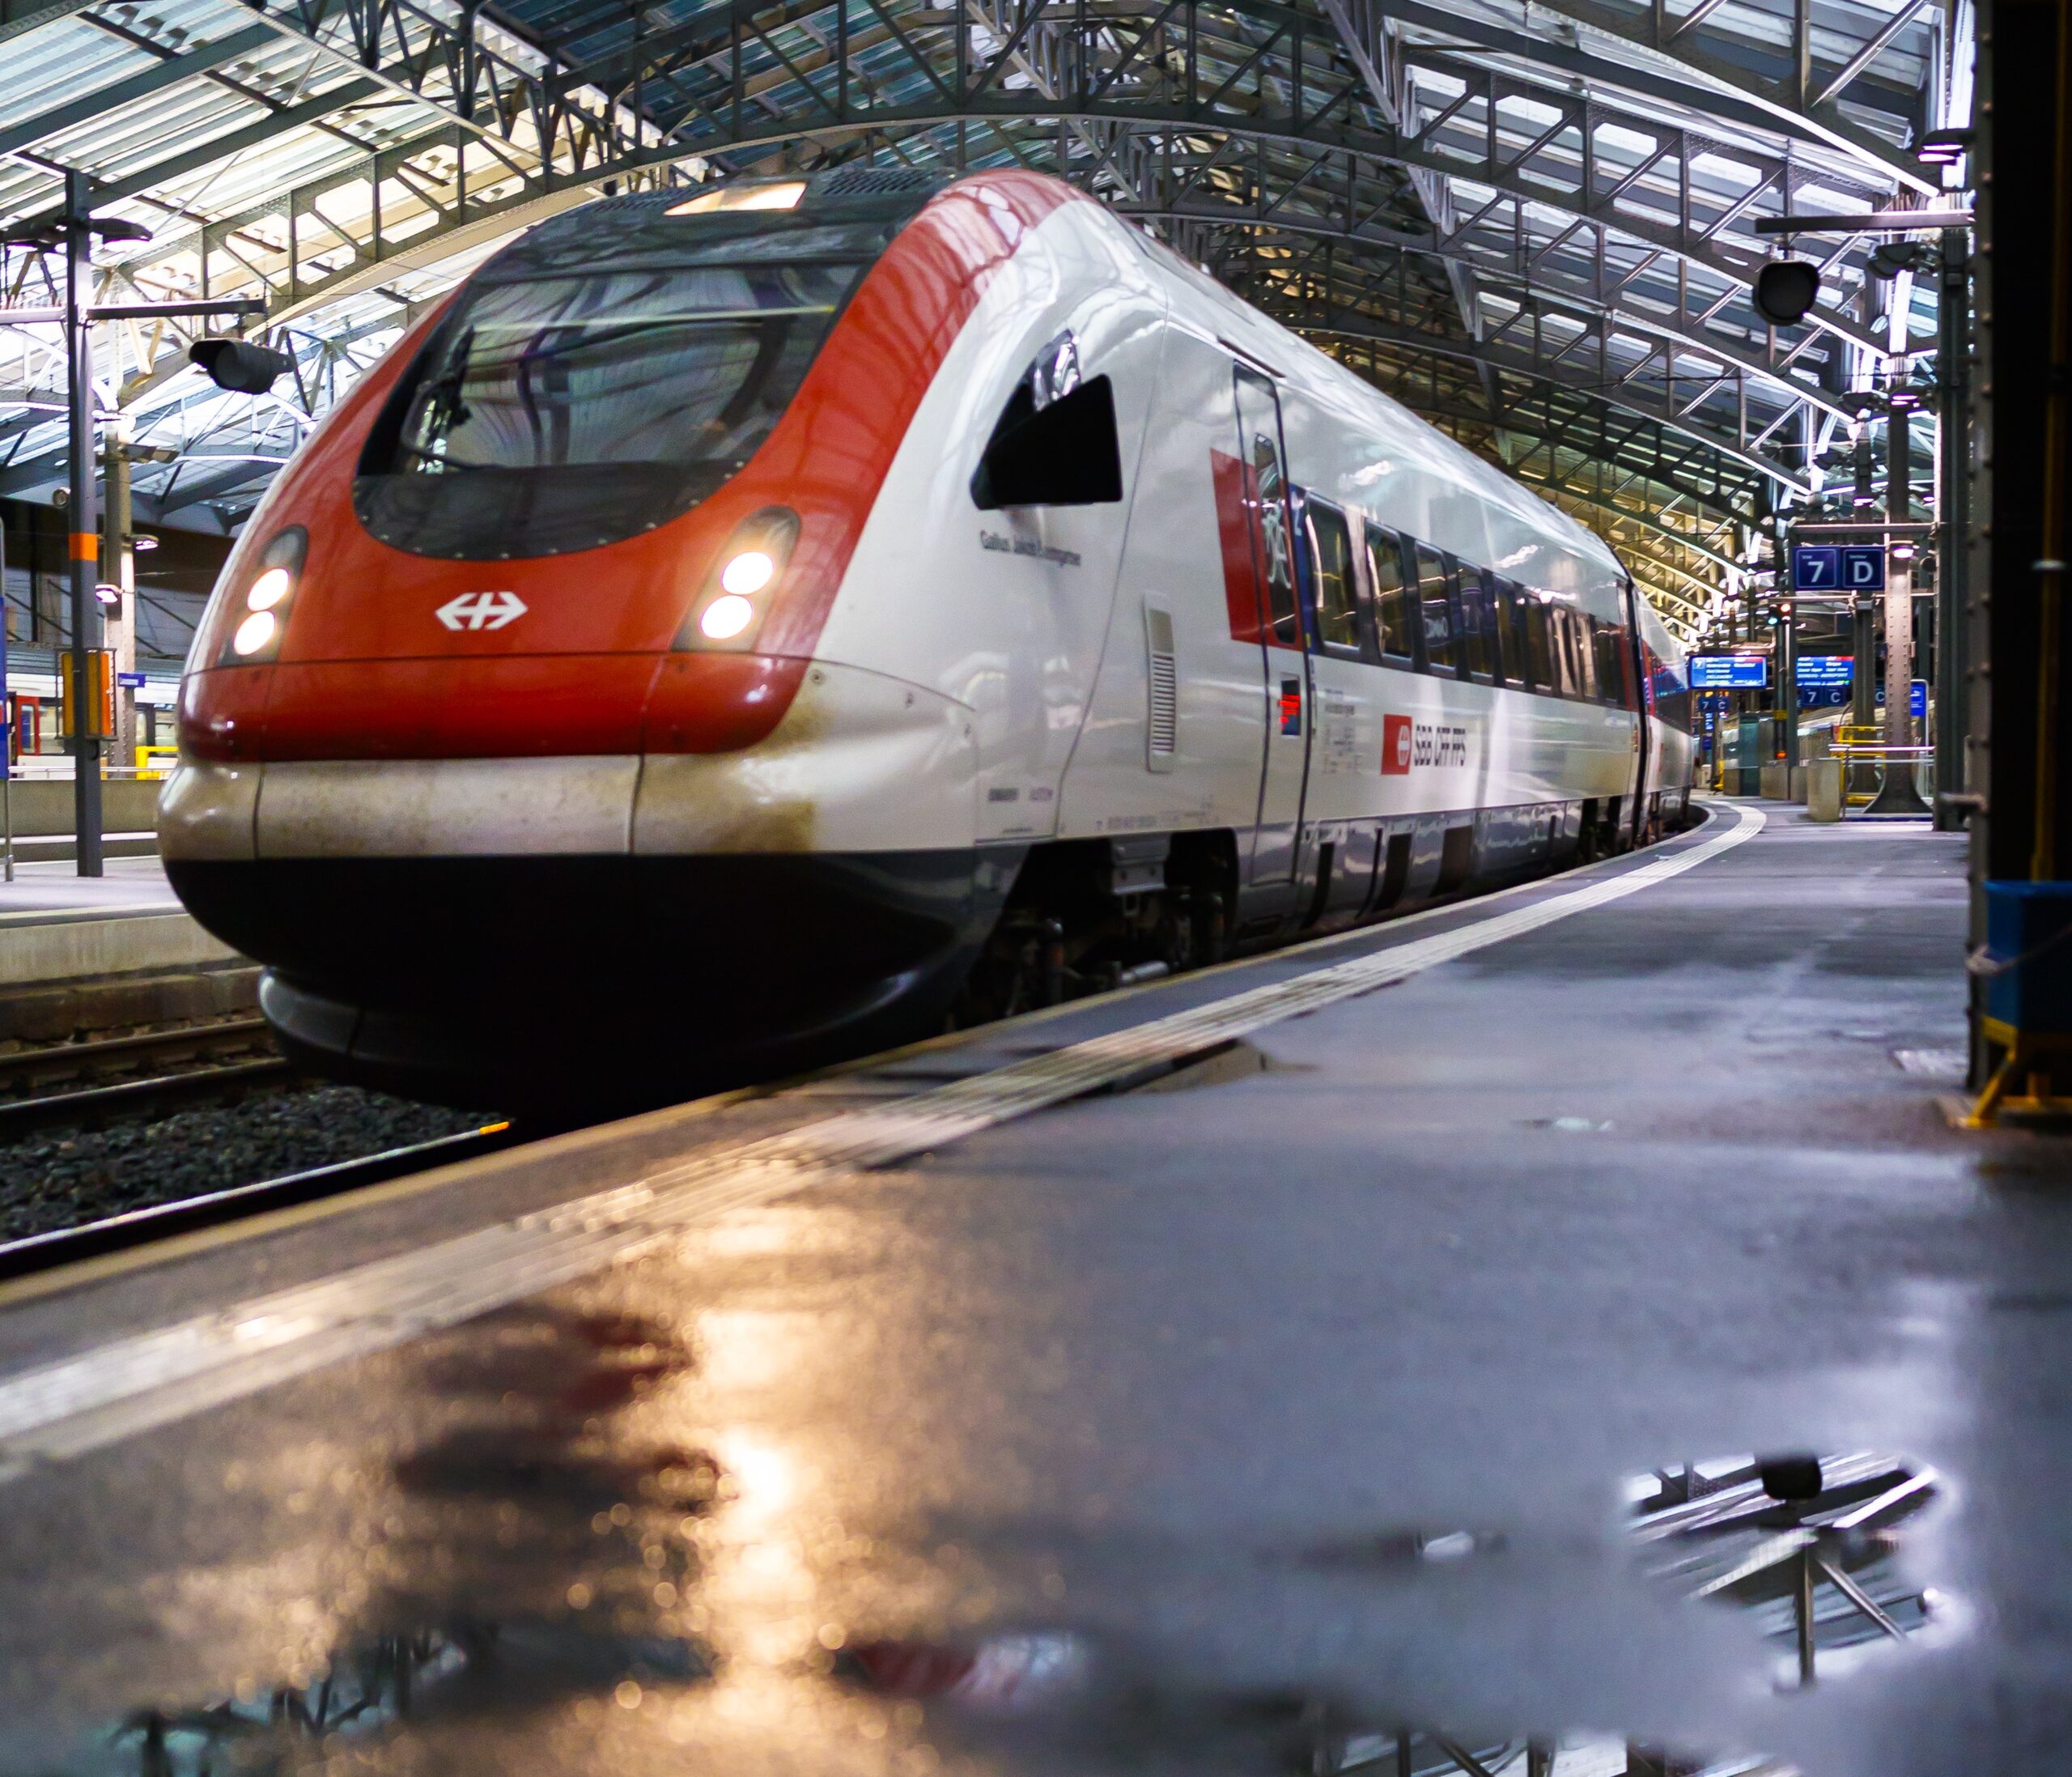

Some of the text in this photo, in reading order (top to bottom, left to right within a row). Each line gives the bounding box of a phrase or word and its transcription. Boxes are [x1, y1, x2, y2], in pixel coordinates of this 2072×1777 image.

[1807, 561, 1824, 583] 7
[1853, 561, 1874, 583] D
[1695, 660, 1703, 668] 7
[1807, 691, 1817, 703] 7
[1830, 692, 1841, 703] C
[1875, 691, 1884, 702] C
[1702, 701, 1709, 709] 7
[1717, 701, 1726, 709] C
